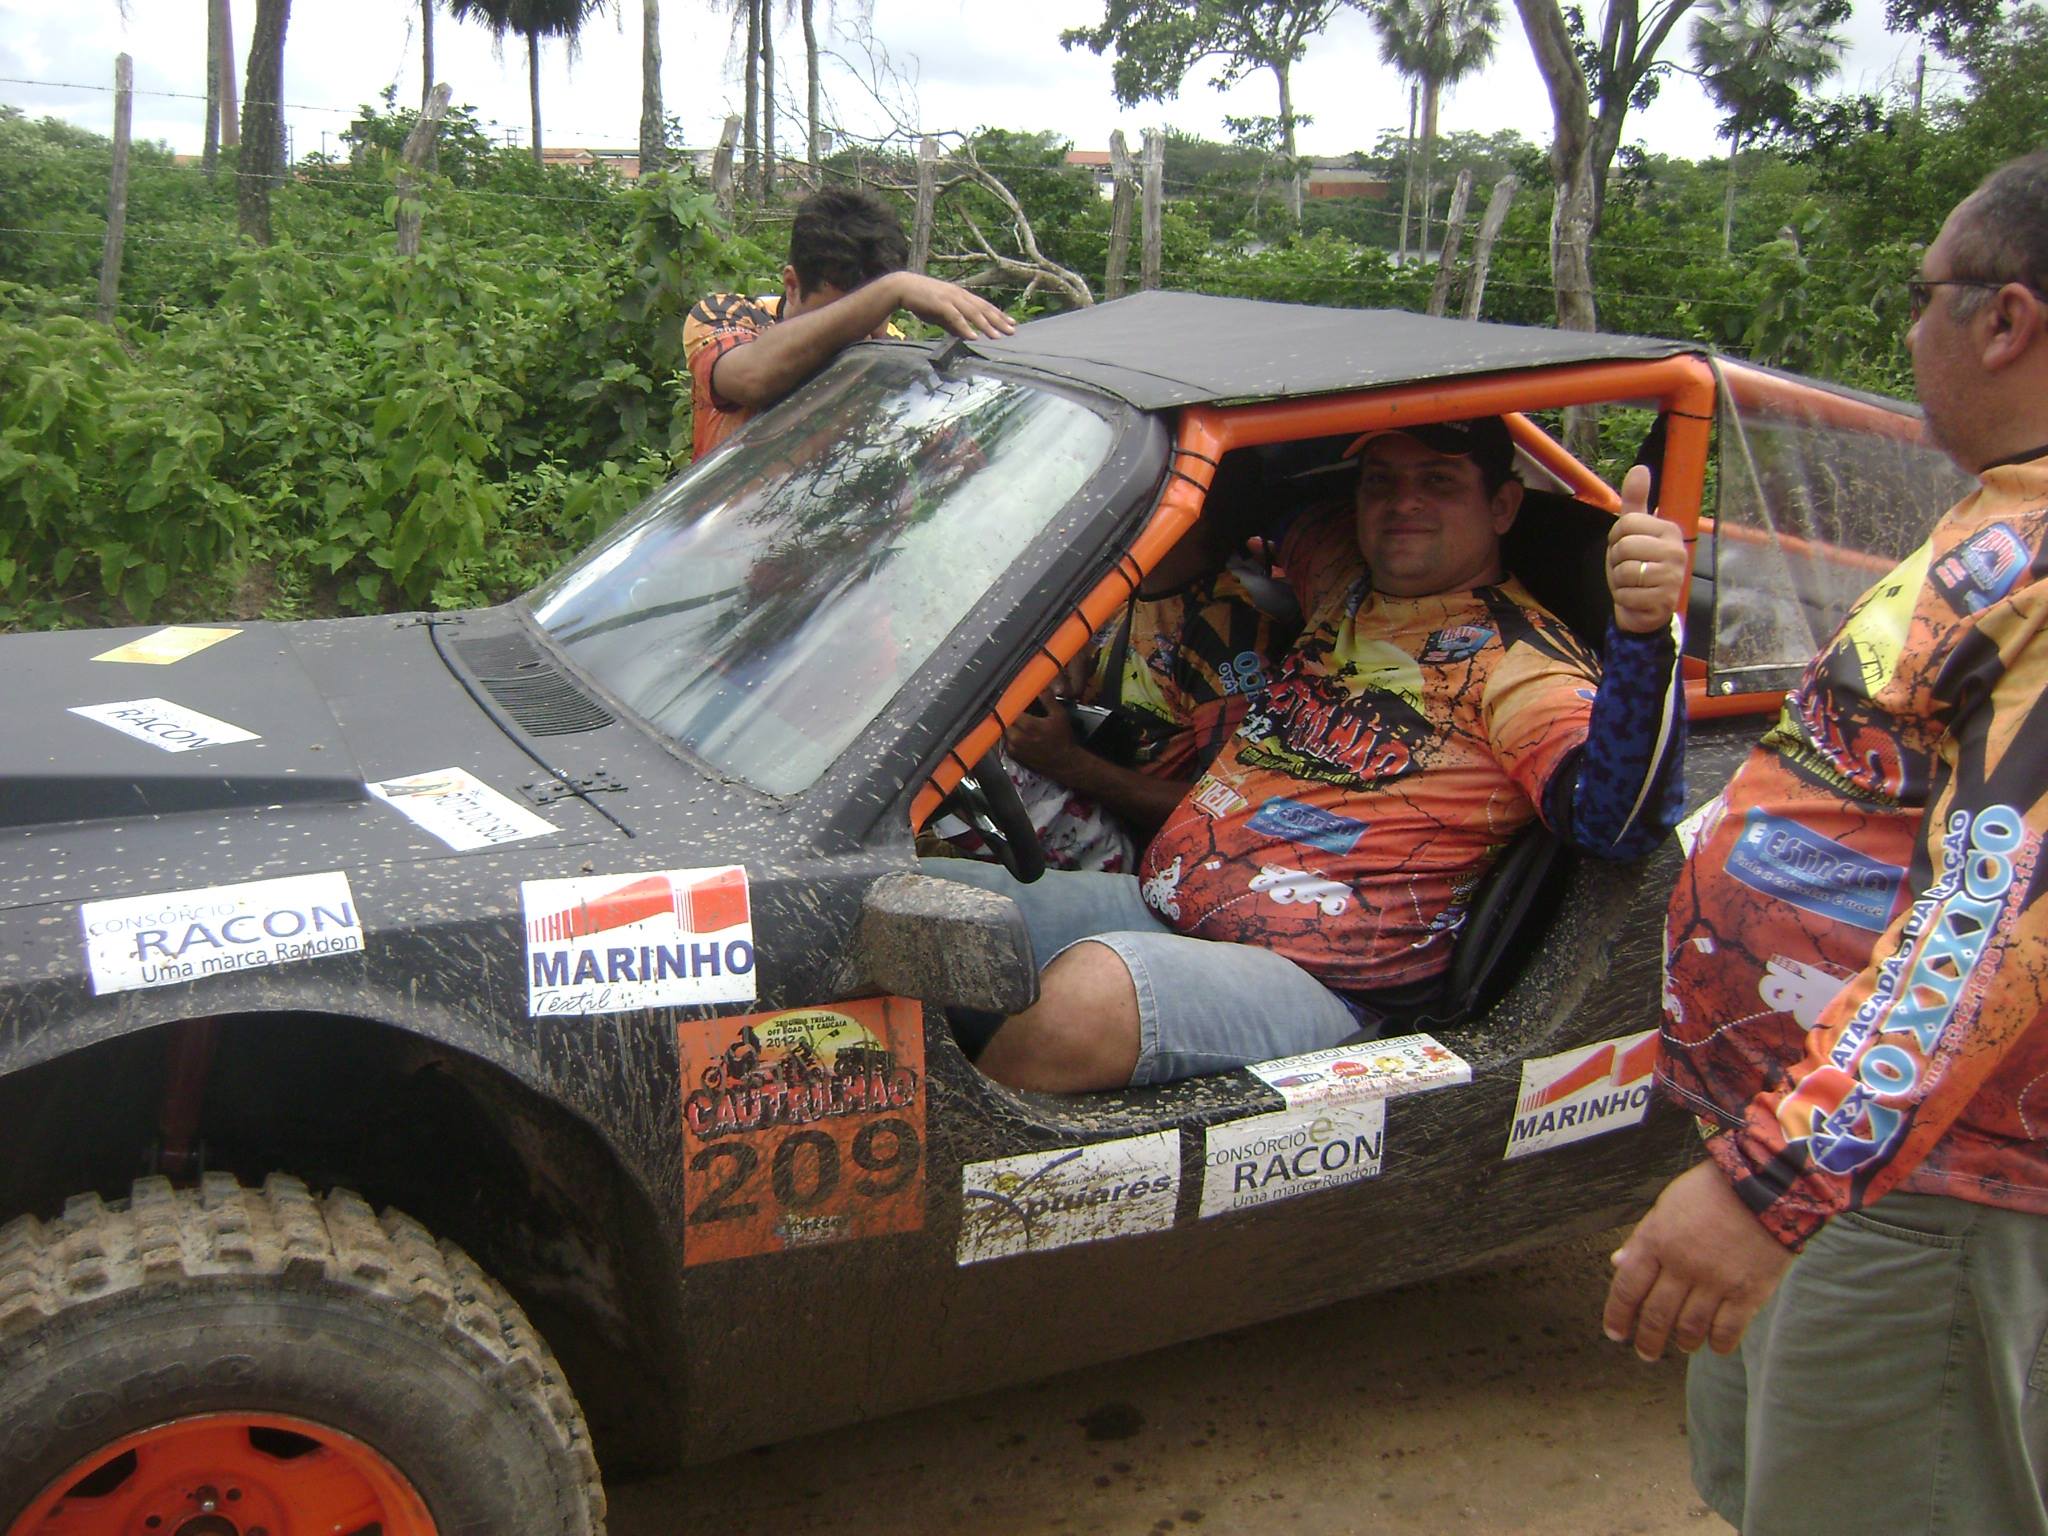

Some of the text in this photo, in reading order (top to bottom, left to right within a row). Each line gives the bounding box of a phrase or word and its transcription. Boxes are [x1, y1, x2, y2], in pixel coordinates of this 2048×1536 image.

[107, 709, 208, 748] RACON
[1764, 829, 1889, 892] ESTRELA
[135, 901, 355, 962] RACON
[1904, 900, 1938, 936] DA
[141, 935, 358, 984] Uma marca Randon
[532, 940, 755, 987] MARINHO
[811, 1015, 835, 1024] TRILHA
[817, 1020, 847, 1030] CAUCAIA
[1301, 1073, 1321, 1083] TIM
[1511, 1085, 1650, 1143] MARINHO
[688, 1118, 920, 1225] 209
[1205, 1131, 1306, 1167] CONSÓRCIO
[1234, 1131, 1381, 1194] RACON
[1233, 1166, 1378, 1209] Uma marca Randon
